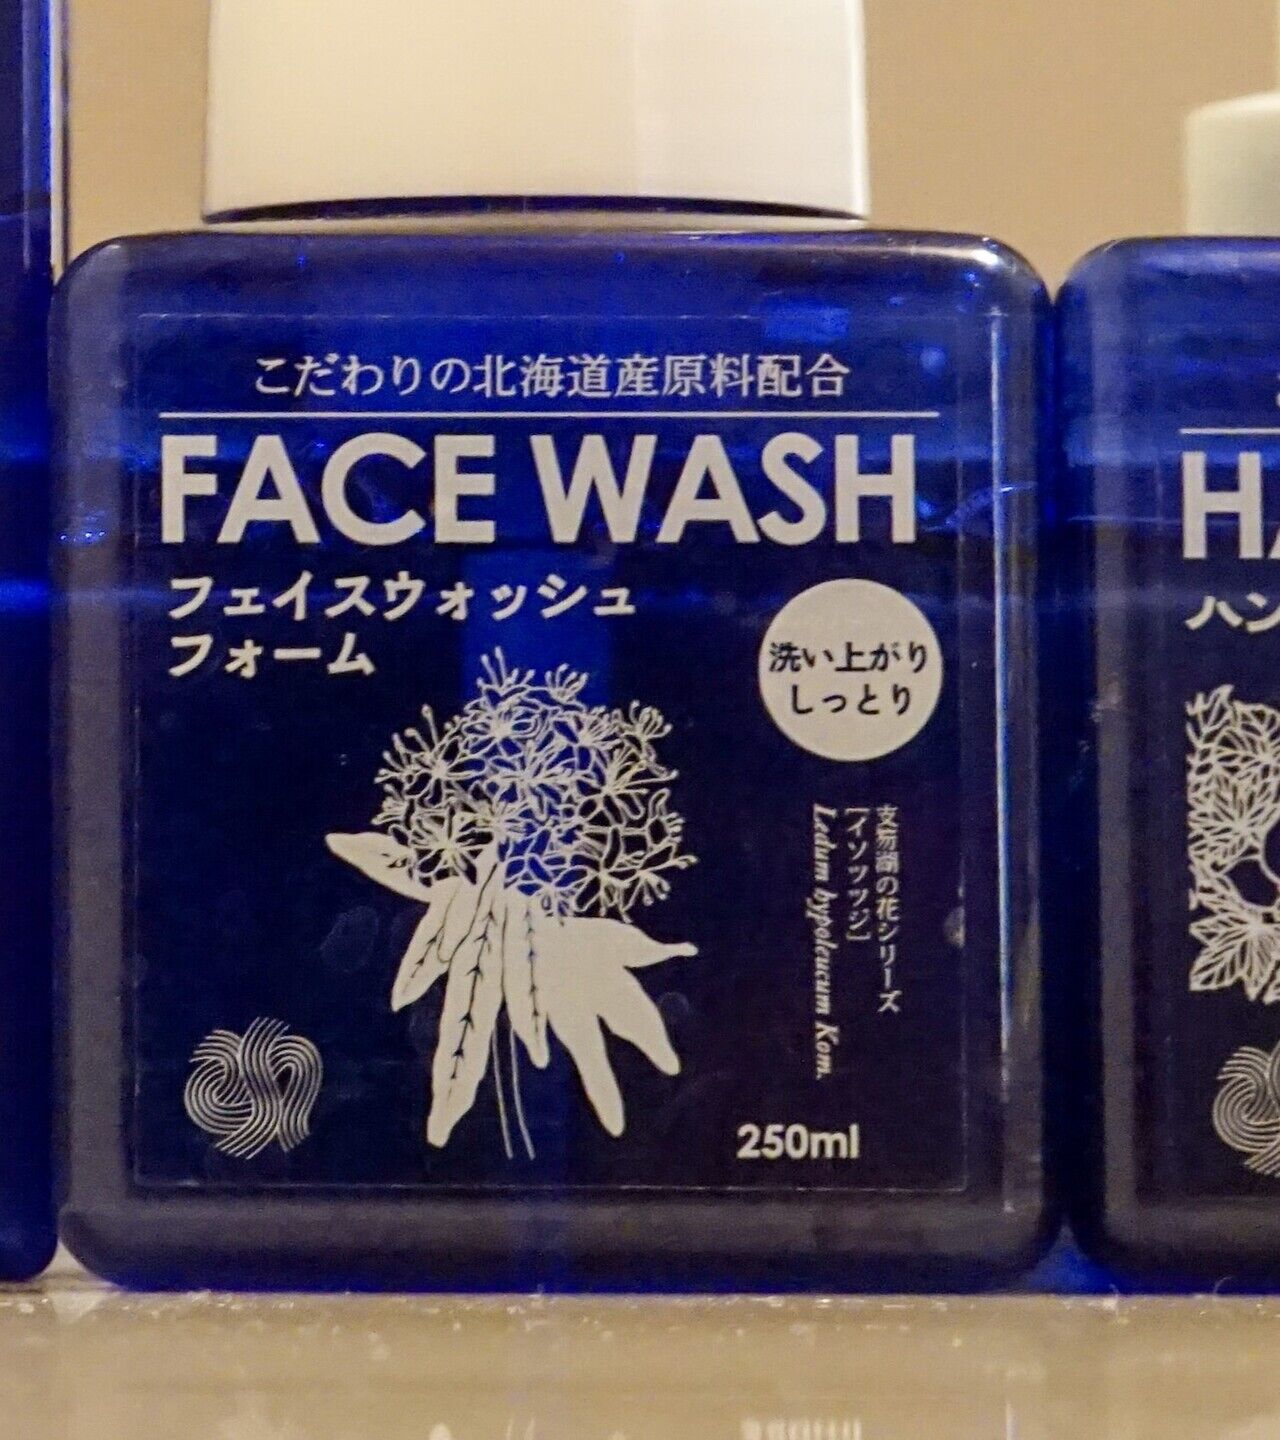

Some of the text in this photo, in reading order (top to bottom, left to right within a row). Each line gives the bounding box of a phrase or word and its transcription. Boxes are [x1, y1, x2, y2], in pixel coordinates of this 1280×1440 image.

[255, 352, 851, 398] こだわりの北海道産原料配合
[160, 431, 917, 546] FACE WASH
[1181, 450, 1280, 560] H
[168, 570, 636, 621] フェイスウォッシュ
[168, 632, 375, 679] フォーム
[768, 641, 928, 674] 洗い上がり
[791, 683, 911, 716] しっとり
[736, 1123, 860, 1159] 250ml
